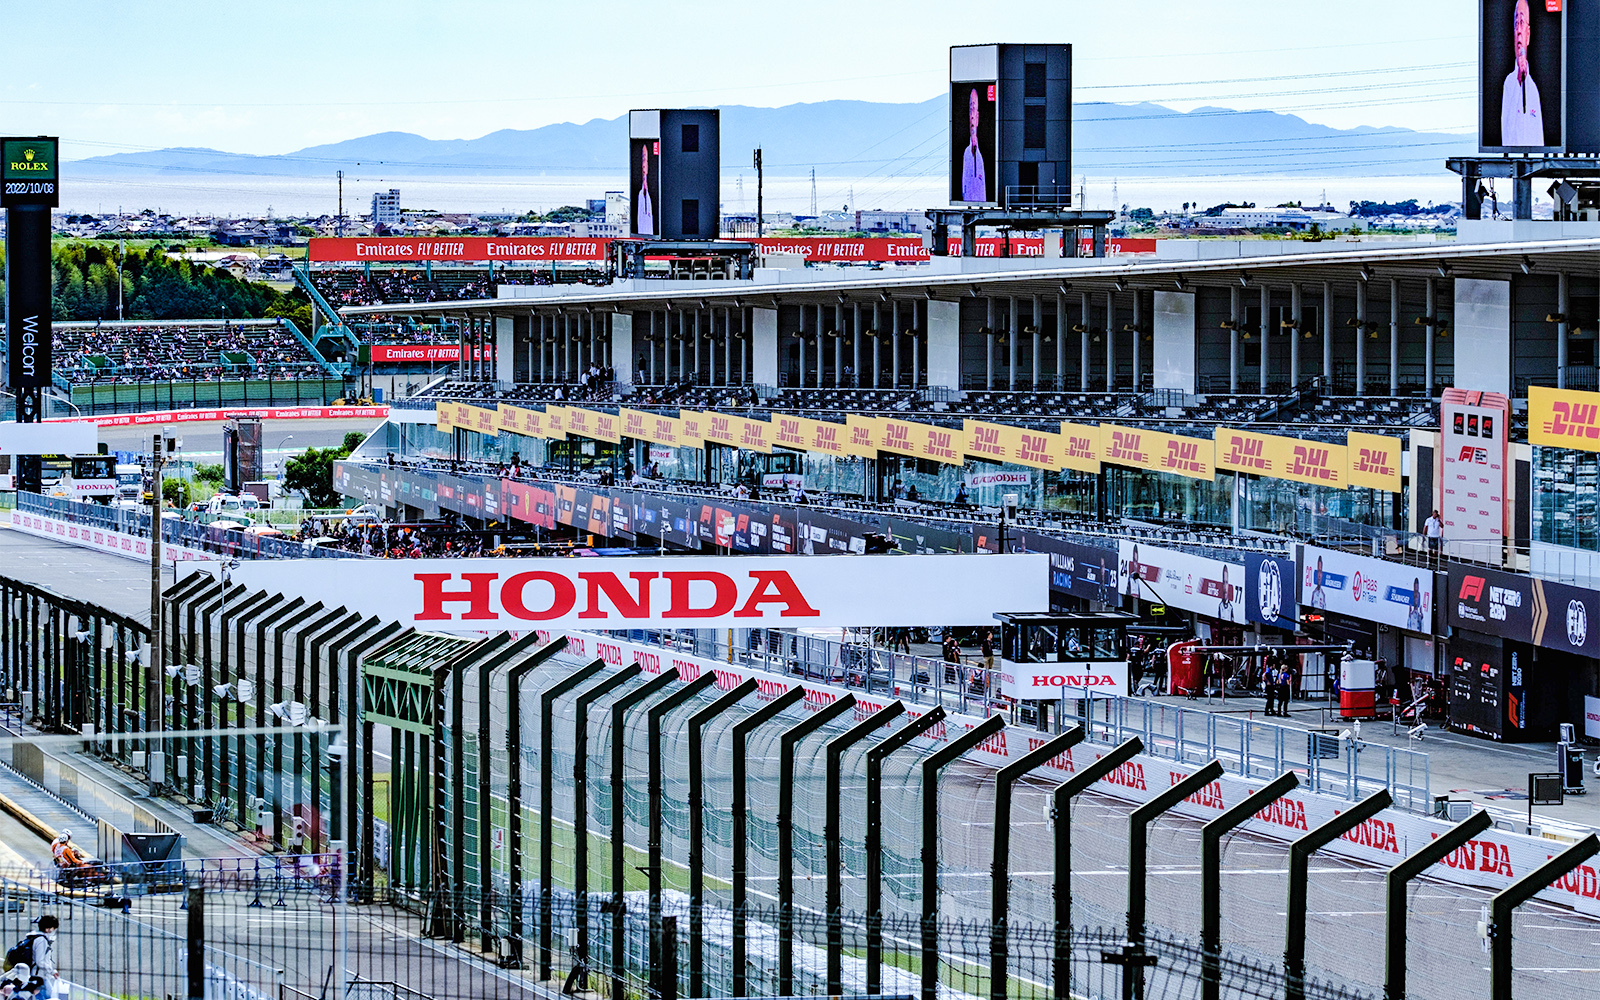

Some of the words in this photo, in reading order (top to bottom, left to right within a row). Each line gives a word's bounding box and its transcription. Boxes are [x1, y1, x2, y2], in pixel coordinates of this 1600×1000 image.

[11, 162, 48, 170] ROLEX
[6, 183, 54, 194] 2022/10/08
[356, 242, 413, 256] Emirates
[417, 242, 432, 255] FLY
[434, 243, 464, 256] BETTER
[487, 242, 545, 256] Emirates
[550, 243, 564, 255] FLY
[566, 243, 597, 256] BETTER
[760, 243, 812, 256] mirates
[817, 244, 832, 256] FLY
[834, 244, 864, 256] BETTER
[386, 348, 424, 358] Emirates
[427, 349, 436, 358] FLY
[438, 349, 460, 358] BETTER
[626, 413, 644, 435] DHL
[655, 419, 674, 442] DHL
[685, 421, 699, 437] DHL
[711, 417, 730, 440] DHL
[779, 419, 801, 443] DHL
[1552, 401, 1600, 439] DHL
[743, 423, 764, 447] DHL
[816, 426, 839, 451] DHL
[852, 426, 870, 446] DHL
[886, 423, 910, 450] DHL
[928, 430, 953, 459] DHL
[974, 427, 1000, 455] DHL
[1112, 431, 1142, 462] DHL
[1020, 434, 1049, 464] DHL
[1069, 437, 1092, 459] DHL
[1166, 440, 1200, 473] DHL
[1230, 436, 1265, 469] DHL
[1293, 445, 1330, 480] DHL
[1358, 448, 1389, 476] DHL
[1053, 571, 1072, 588] RACING
[1120, 559, 1128, 577] 24
[1363, 574, 1377, 592] Haas
[414, 570, 820, 621] HONDA
[1235, 586, 1242, 604] 77
[1490, 586, 1503, 603] NET
[1503, 588, 1522, 608] ZERO
[1489, 602, 1506, 621] 2030
[597, 642, 622, 666] HONDA
[634, 651, 661, 675] HONDA
[673, 659, 700, 683] HONDA
[714, 669, 743, 691] HONDA
[1032, 676, 1116, 686] HONDA
